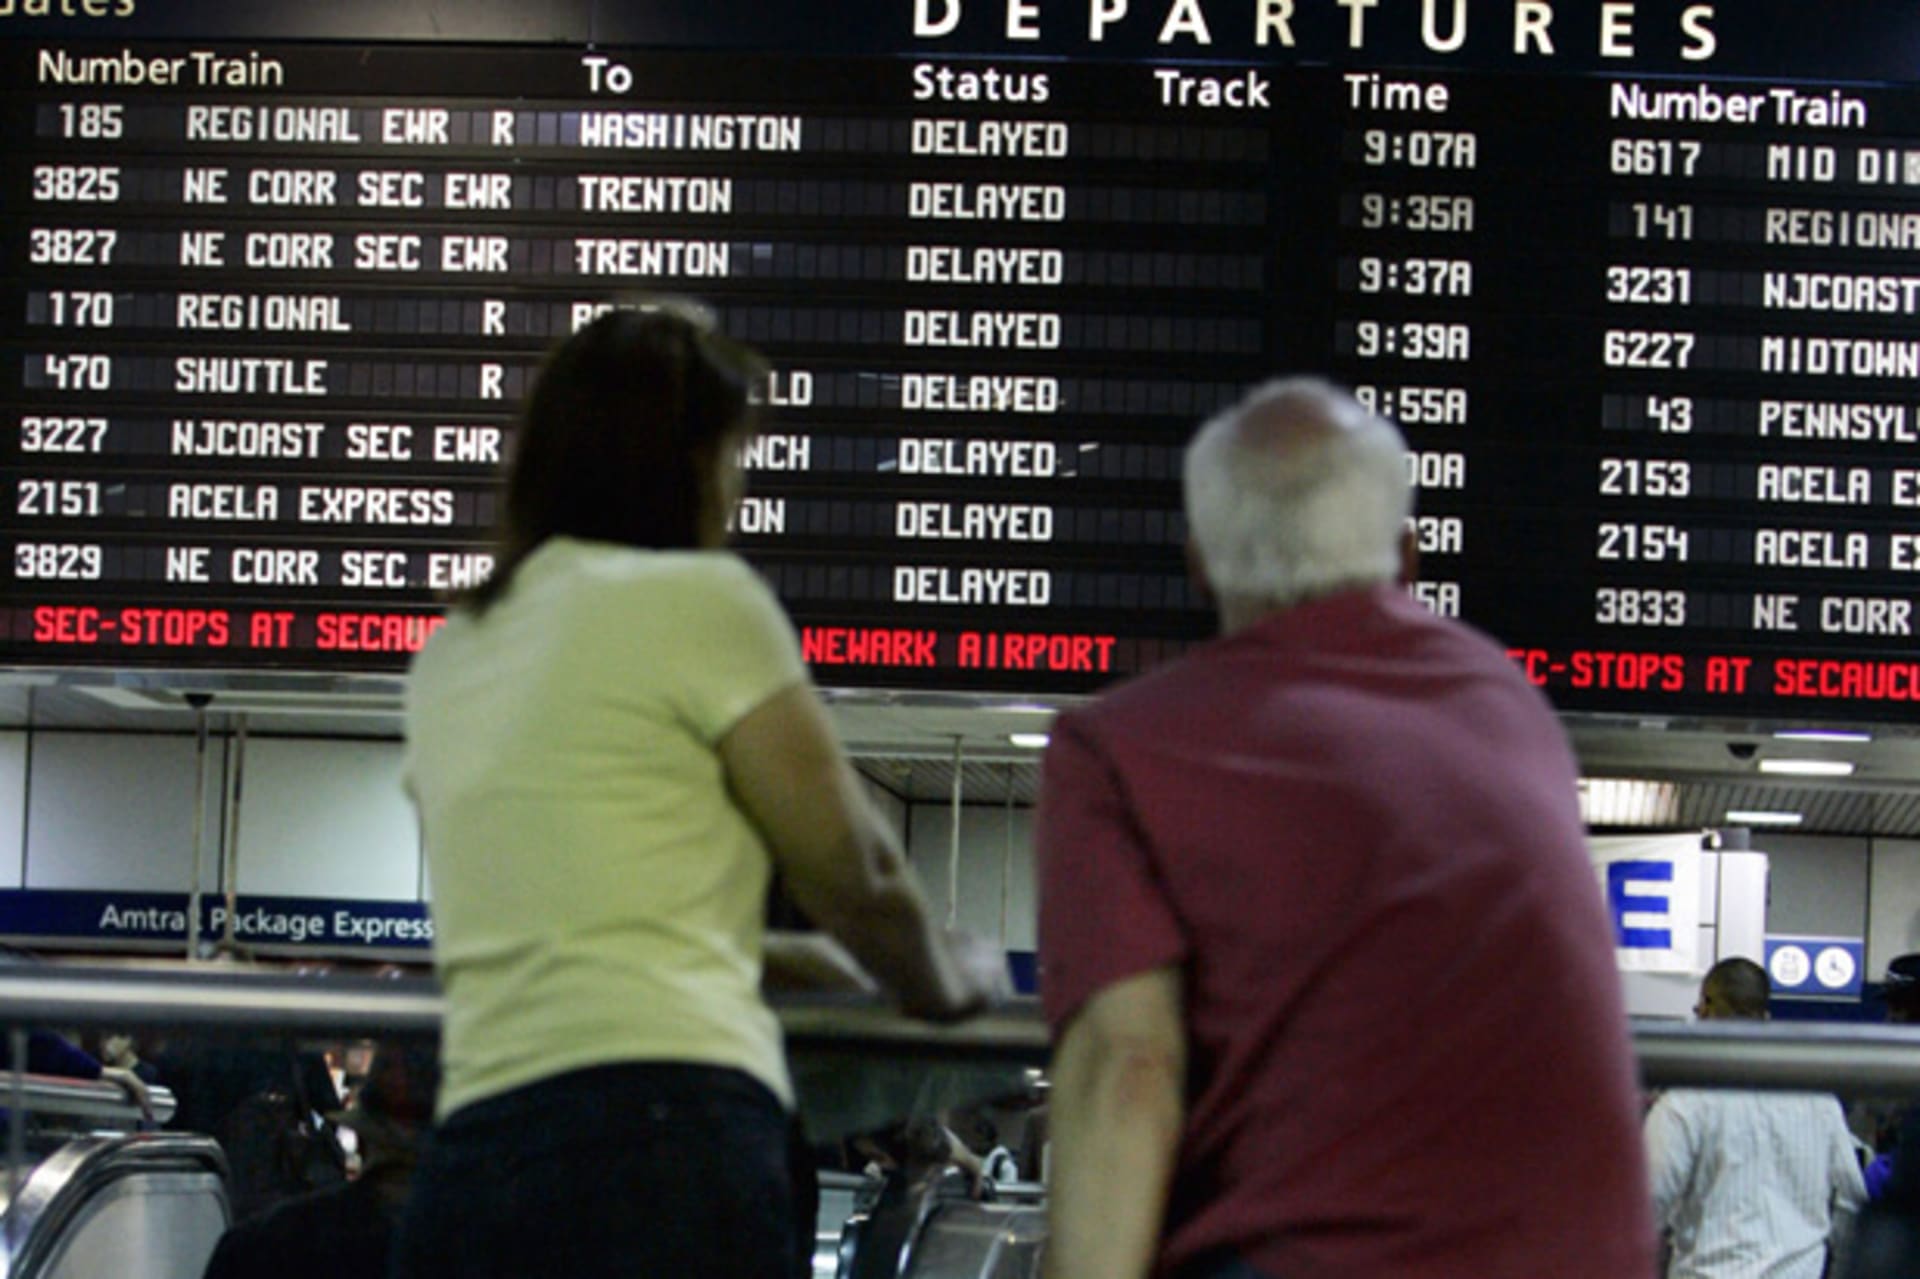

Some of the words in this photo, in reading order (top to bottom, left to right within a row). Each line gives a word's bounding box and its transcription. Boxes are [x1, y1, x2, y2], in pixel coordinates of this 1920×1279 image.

[913, 0, 1717, 59] DEPARTURES
[39, 49, 185, 85] Number
[191, 51, 283, 86] Train
[582, 57, 632, 93] To
[913, 63, 1049, 102] Status
[1154, 69, 1269, 107] Track
[1344, 73, 1449, 112] Time
[1611, 83, 1766, 123] Number
[1769, 89, 1866, 127] Train
[61, 104, 123, 138] 185
[187, 106, 361, 143] REGIONAL
[382, 108, 449, 144] EWR
[492, 110, 514, 145] R
[579, 113, 801, 151] WASHINGTON
[912, 119, 1068, 157] DELAYED
[1365, 130, 1476, 167] 9:07A
[1611, 139, 1701, 176] 6617
[1768, 145, 1836, 181] MID
[33, 166, 119, 201] 3825
[183, 169, 227, 203] NE
[249, 170, 336, 205] CORR
[358, 171, 424, 207] SEC
[444, 173, 511, 209] EWR
[578, 175, 731, 213] TRENTON
[909, 183, 1065, 221] DELAYED
[1363, 195, 1473, 231] 9:35A
[1633, 204, 1692, 240] 141
[1766, 209, 1920, 250] REGIONA
[30, 229, 117, 264] 3827
[180, 232, 225, 266] NE
[245, 233, 334, 268] CORR
[355, 234, 421, 270] SEC
[441, 236, 508, 272] EWR
[575, 238, 729, 276] TRENTON
[907, 246, 1063, 284] DELAYED
[1360, 258, 1472, 296] 9:37A
[1607, 266, 1691, 304] 3231
[1763, 273, 1920, 313] NJCOAST
[50, 291, 113, 327] 170
[177, 294, 351, 331] REGIONAL
[483, 300, 505, 335] R
[904, 310, 1060, 348] DELAYED
[1358, 322, 1470, 359] 9:39A
[1604, 330, 1694, 368] 6227
[1761, 337, 1920, 378] MIDTOWN
[46, 354, 111, 390] 470
[175, 357, 327, 395] SHUTTLE
[480, 363, 503, 399] R
[901, 374, 1058, 412] DELAYED
[1356, 386, 1467, 424] 9:55A
[1647, 396, 1692, 433] 43
[1760, 401, 1920, 442] PENNSYL
[21, 417, 108, 452] 3227
[172, 420, 325, 458] NJCOAST
[347, 424, 412, 460] SEC
[433, 426, 500, 462] EWR
[898, 439, 1056, 477] DELAYED
[1600, 459, 1691, 497] 2153
[1757, 465, 1871, 504] ACELA
[17, 480, 102, 516] 2151
[169, 484, 278, 520] ACELA
[299, 487, 453, 525] EXPRESS
[896, 502, 1053, 541] DELAYED
[1598, 524, 1688, 561] 2154
[1755, 529, 1869, 568] ACELA
[15, 543, 102, 579] 3829
[166, 547, 210, 582] NE
[231, 549, 319, 585] CORR
[341, 551, 407, 587] SEC
[894, 567, 1051, 605] DELAYED
[33, 606, 229, 646] SEC-STOPS
[250, 611, 294, 648] AT
[1596, 588, 1686, 626] 3833
[1753, 594, 1798, 630] NE
[1821, 597, 1912, 635] CORR
[801, 626, 938, 668] NEWARK
[958, 631, 1115, 672] AIRPORT
[1706, 656, 1751, 693] AT
[210, 908, 325, 940] Package
[333, 912, 434, 943] Express
